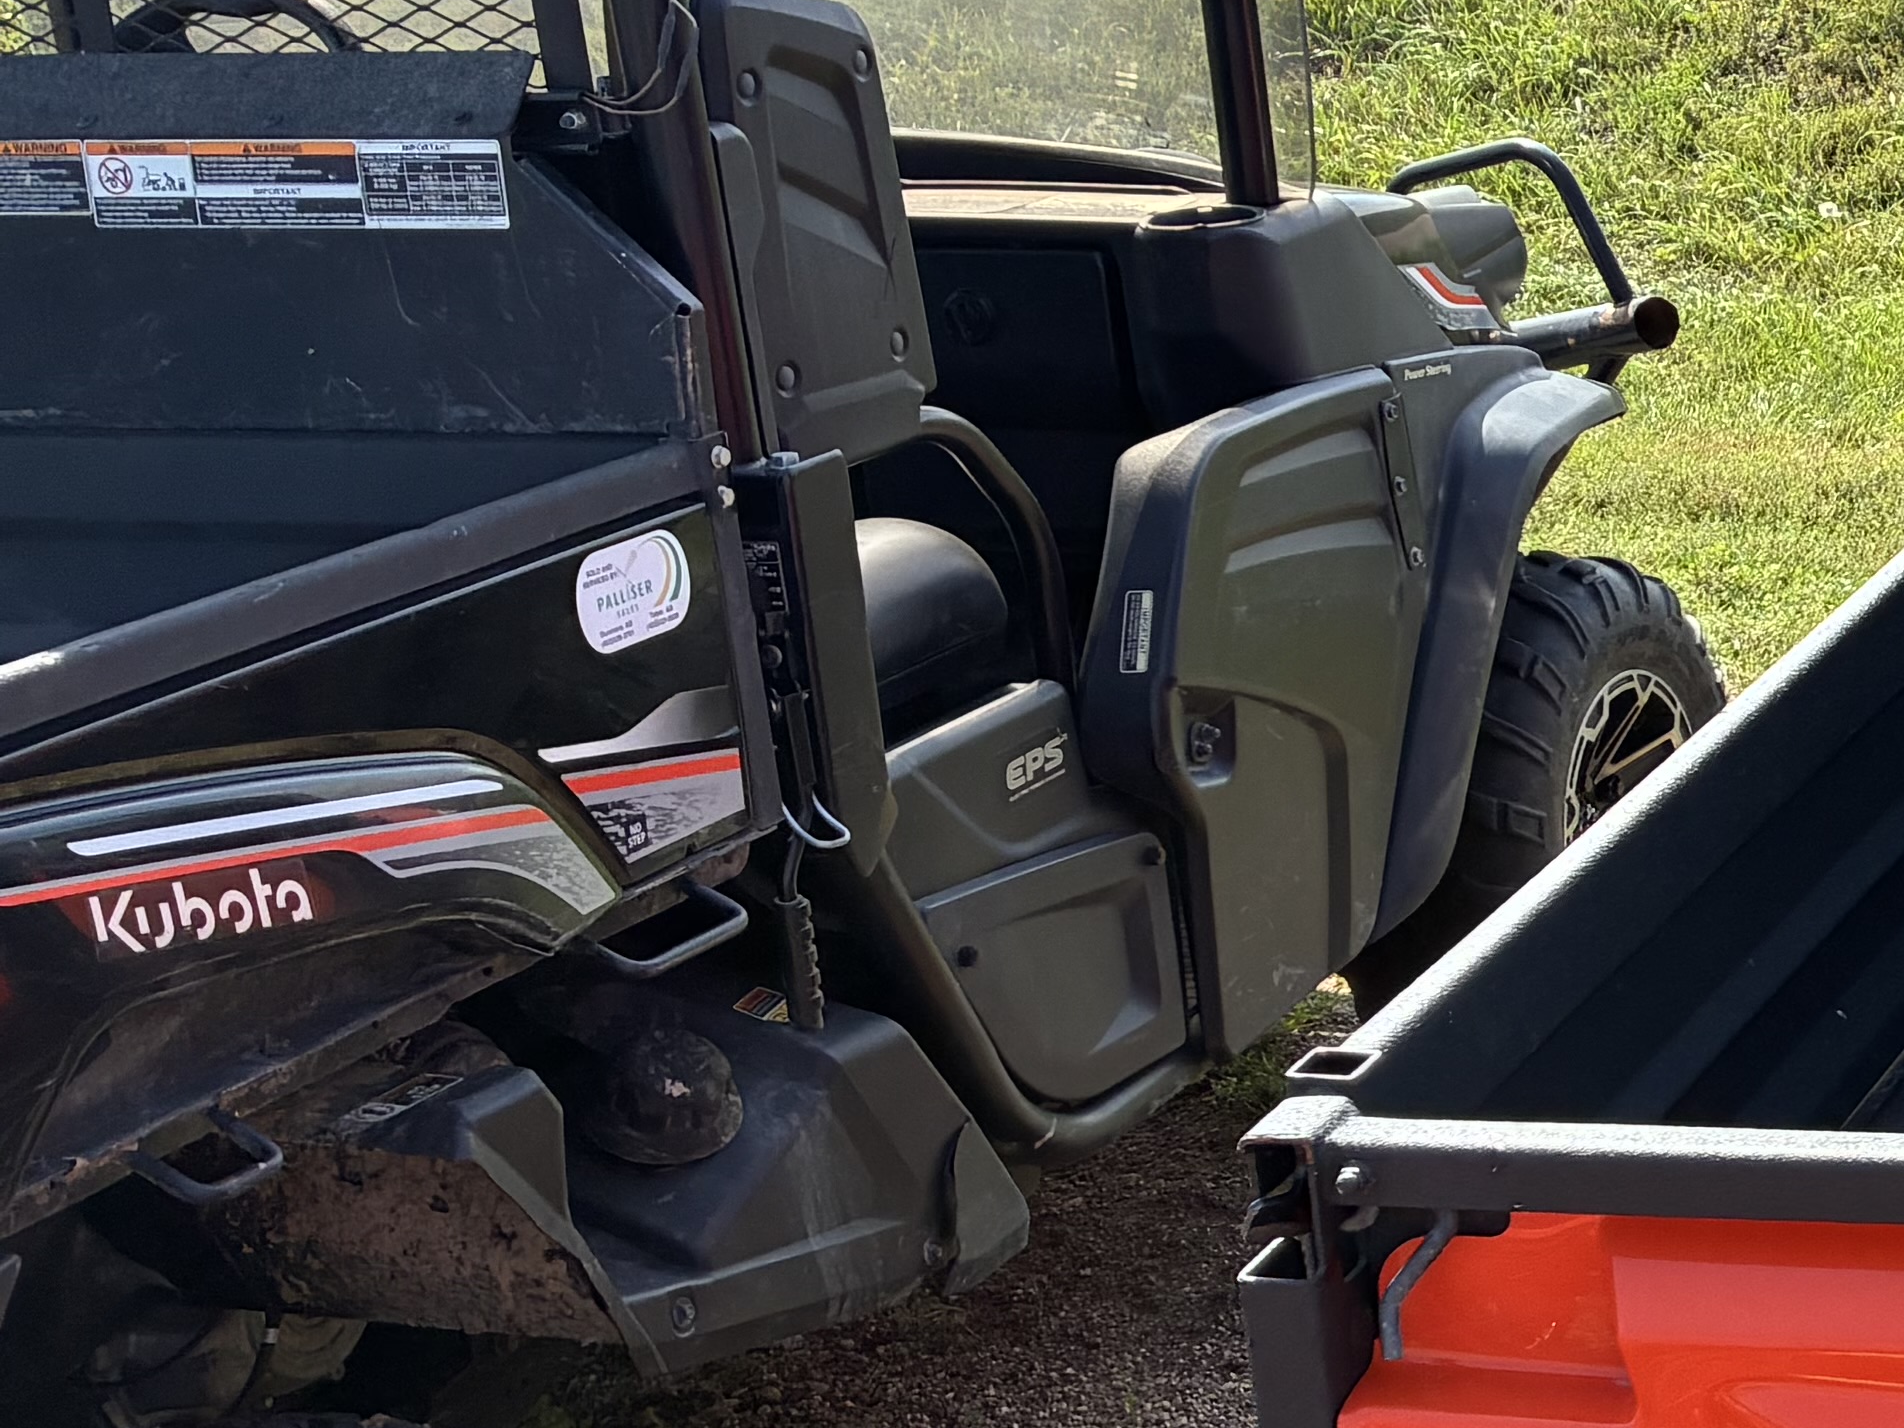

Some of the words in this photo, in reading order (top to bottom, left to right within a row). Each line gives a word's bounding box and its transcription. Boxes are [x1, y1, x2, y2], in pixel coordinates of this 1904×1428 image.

[596, 579, 654, 613] PALLISER
[1006, 735, 1066, 790] EPS
[627, 832, 646, 849] STEP
[629, 821, 643, 835] NO
[88, 868, 314, 953] Kubota
